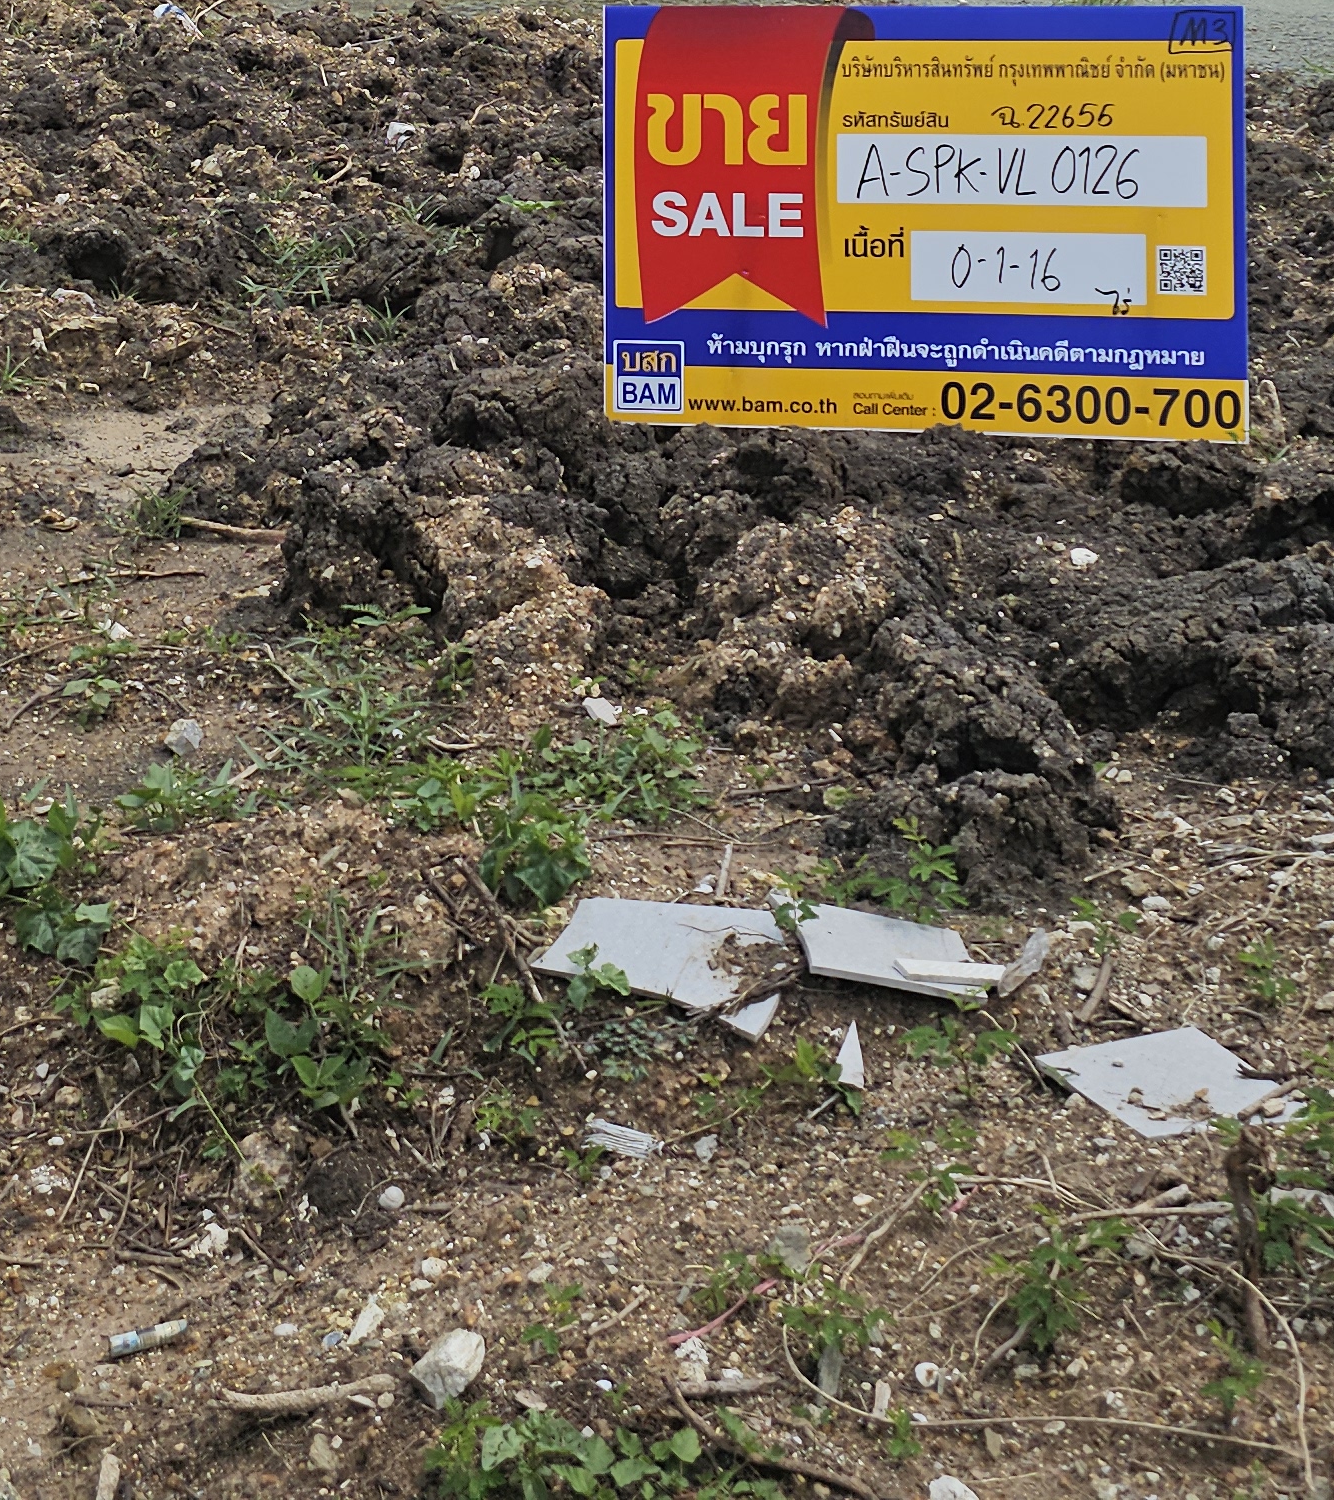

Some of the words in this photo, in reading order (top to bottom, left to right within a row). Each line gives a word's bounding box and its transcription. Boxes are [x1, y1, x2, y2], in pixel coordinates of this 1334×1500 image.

[841, 55, 996, 79] บริษัทบริหารสินทรัพย์
[1115, 56, 1155, 79] จำกัด
[1160, 61, 1225, 84] (มหาชน)
[647, 93, 808, 166] ขาย
[842, 110, 950, 128] รหัสทรัพย์สิน
[651, 190, 804, 238] SALE
[844, 224, 905, 258] เนื้อที่
[951, 244, 1061, 292] 0-1-16
[621, 350, 677, 373] บสก
[706, 332, 806, 364] ห้ามบุกรุก
[622, 382, 676, 405] BAM
[688, 396, 838, 415] www.bam.co.th
[940, 381, 1242, 431] 02-6300-700
[853, 402, 879, 415] Call
[882, 402, 928, 417] Center
